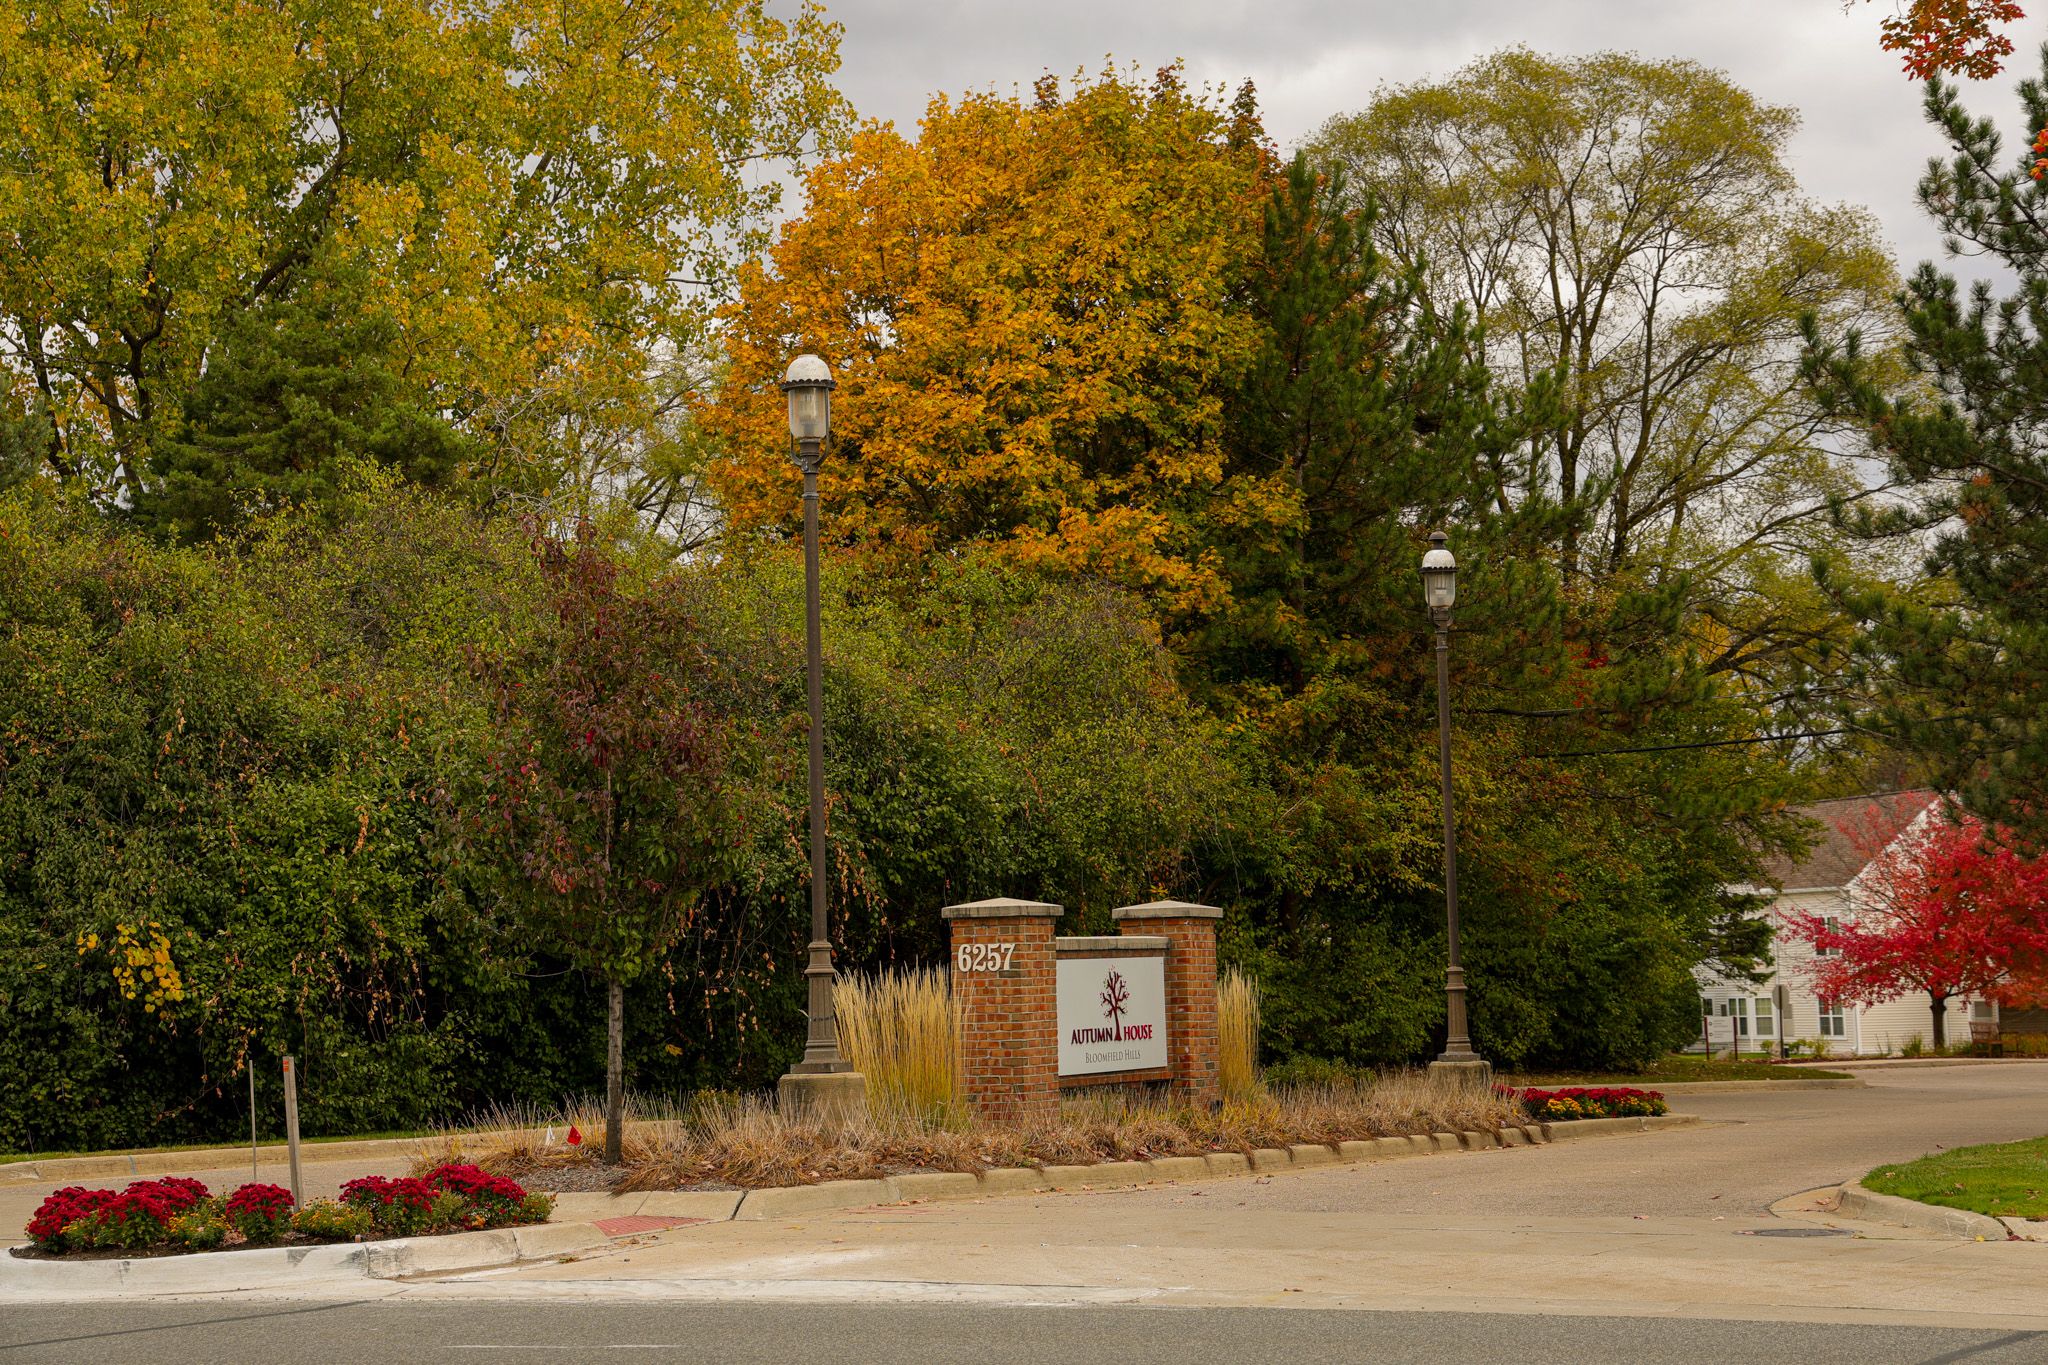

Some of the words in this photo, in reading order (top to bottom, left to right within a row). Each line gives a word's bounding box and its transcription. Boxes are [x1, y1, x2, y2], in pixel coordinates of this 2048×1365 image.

[958, 943, 1016, 972] 6257
[1071, 1027, 1113, 1045] AUTUMN
[1123, 1024, 1153, 1041] HOUSE
[1085, 1051, 1124, 1063] BLOOMFIELD
[1124, 1049, 1141, 1060] HILLS
